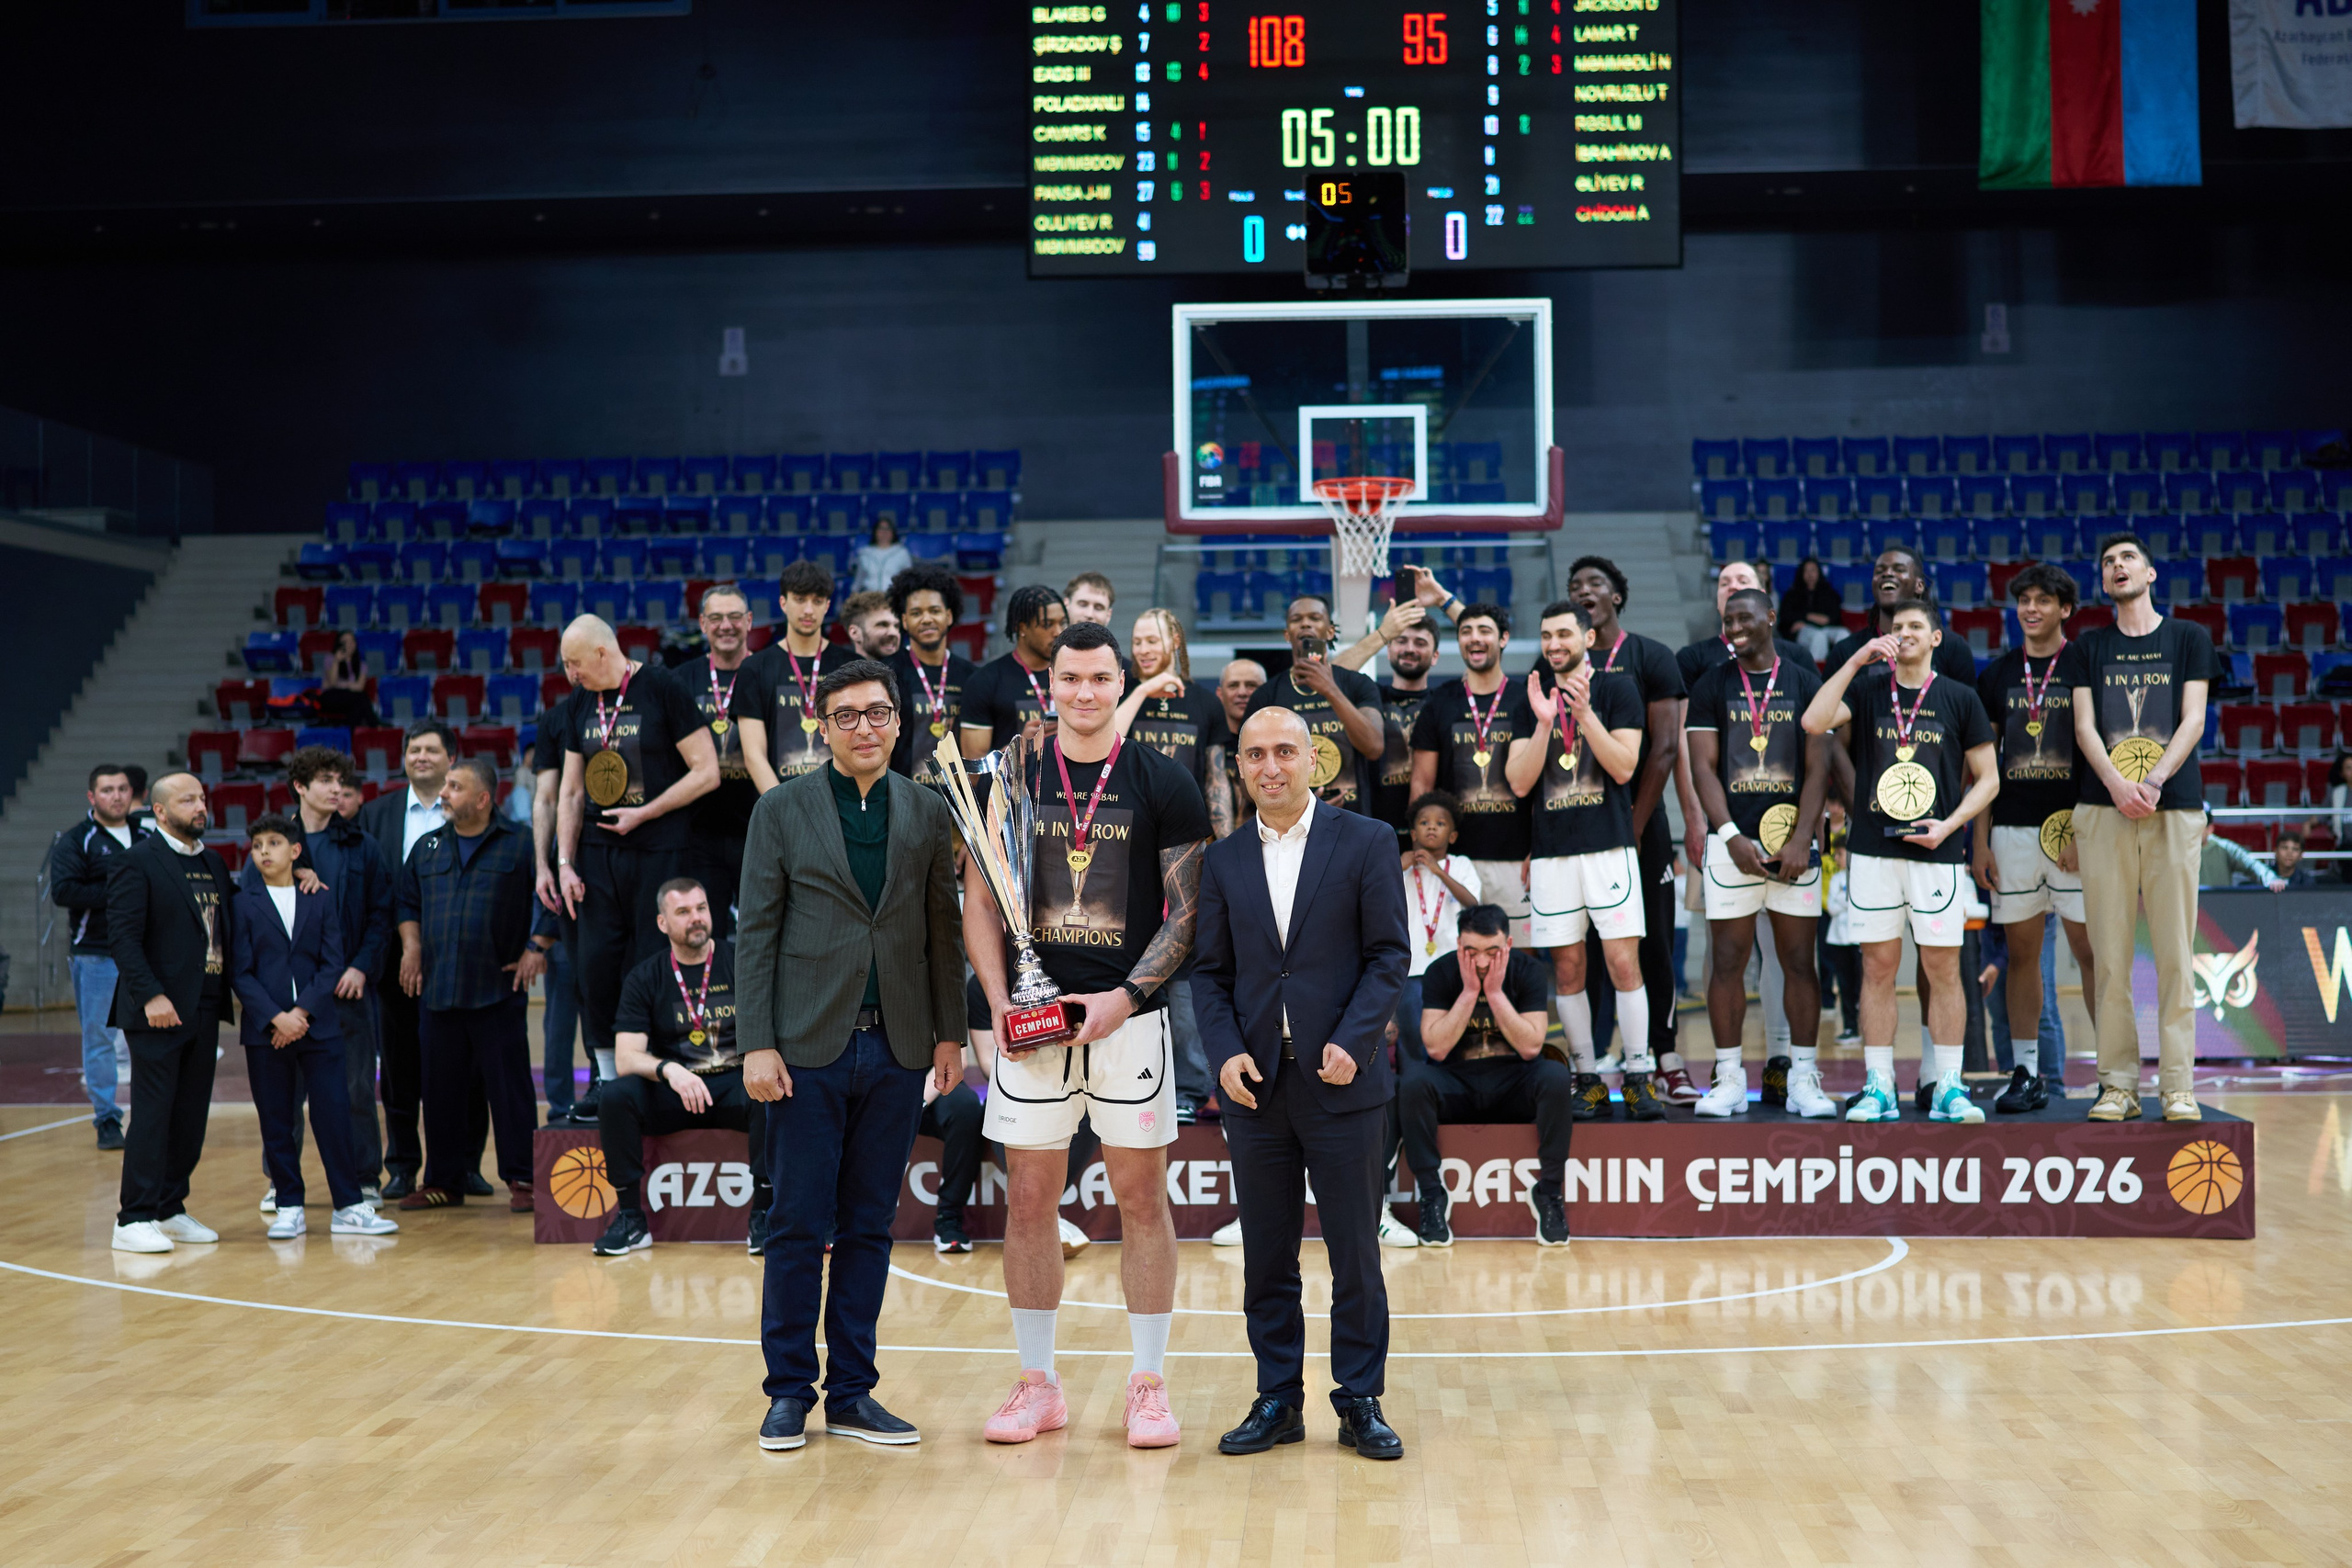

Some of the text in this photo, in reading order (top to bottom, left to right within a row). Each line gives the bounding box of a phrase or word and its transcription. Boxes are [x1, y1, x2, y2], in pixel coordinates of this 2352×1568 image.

[1199, 2, 1209, 22] 3
[1199, 31, 1210, 51] 2
[1249, 16, 1305, 68] 108
[1403, 13, 1448, 64] 95
[1551, 54, 1562, 74] 3
[1282, 107, 1420, 167] 05:00
[1199, 151, 1211, 171] 2
[1200, 180, 1211, 200] 3
[1244, 215, 1264, 263] 0
[1445, 211, 1467, 260] 0
[1199, 475, 1222, 487] FIBA
[2106, 673, 2171, 686] 4 IN A ROW
[790, 696, 801, 707] IN
[1160, 702, 1169, 711] 3
[2008, 697, 2014, 708] 4
[2045, 696, 2070, 708] ROW
[1730, 709, 1793, 722] 4 IN ROW
[616, 725, 639, 737] ROW
[1312, 723, 1319, 734] A
[1877, 727, 1883, 739] 4
[1915, 730, 1942, 744] ROW
[1145, 731, 1157, 742] IN
[1160, 732, 1169, 743] A
[1171, 733, 1196, 746] ROW
[1464, 732, 1476, 743] IN
[2007, 768, 2070, 779] CHAMPIONS
[1730, 781, 1793, 793] CHAMPIONS
[1073, 792, 1088, 800] ARE
[1546, 794, 1603, 810] CHAMPIONS
[1460, 799, 1515, 812] HAMPIONS
[1052, 821, 1069, 837] IN
[1091, 824, 1130, 840] ROW
[1033, 928, 1123, 947] CHAMPIONS
[704, 1008, 712, 1020] A
[1015, 1016, 1059, 1036] ÇEMPİON
[998, 1114, 1016, 1123] BRIDGE
[1685, 1145, 1981, 1211] ÇEMPİONU
[2000, 1156, 2143, 1205] 2026
